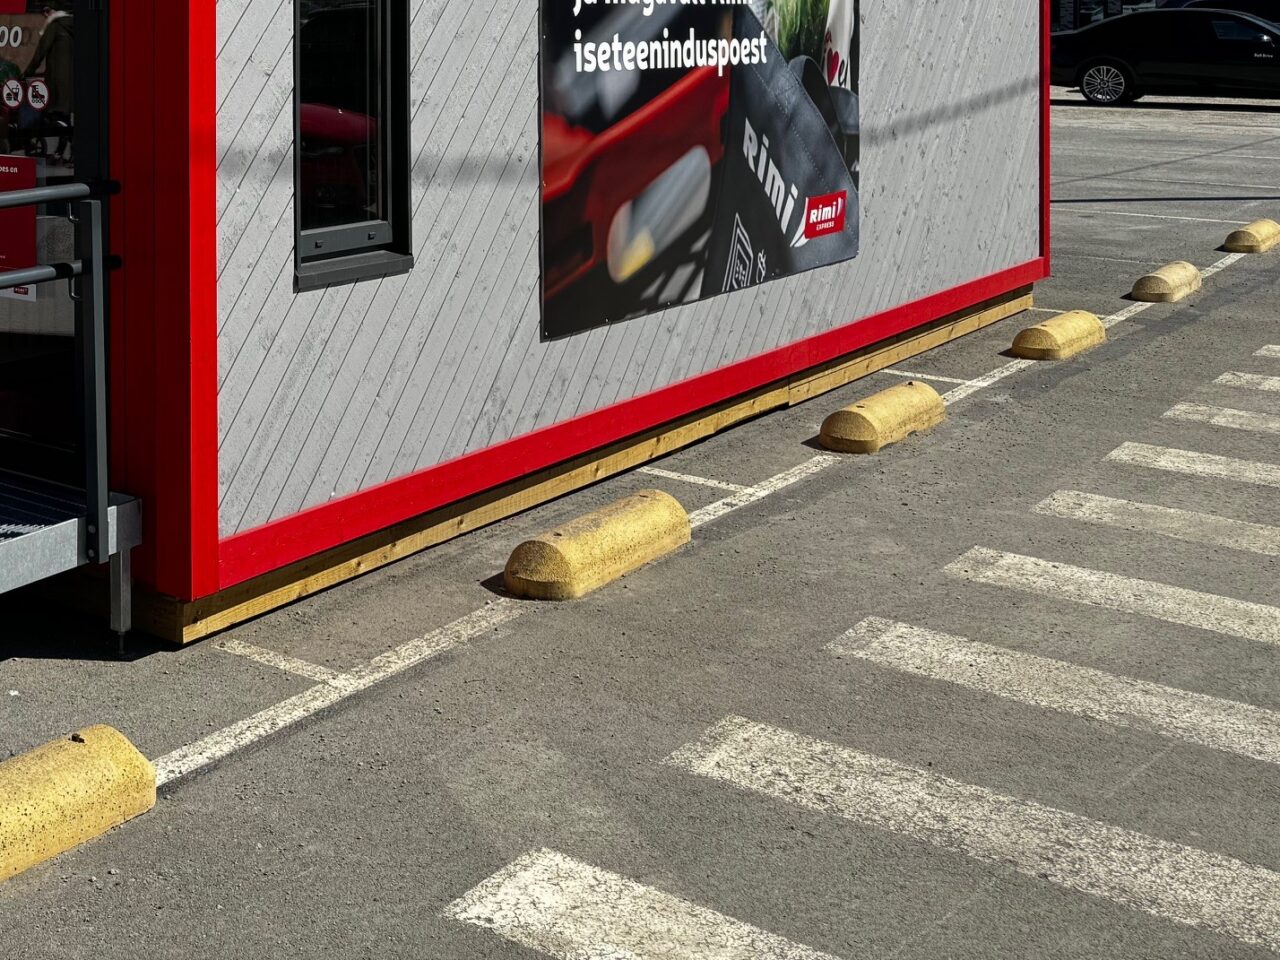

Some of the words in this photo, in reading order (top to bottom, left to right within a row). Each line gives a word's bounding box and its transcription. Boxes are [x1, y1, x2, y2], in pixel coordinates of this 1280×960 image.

[573, 28, 768, 76] iseteeninduspoest
[743, 116, 799, 235] Rimi
[809, 201, 837, 224] Rimi
